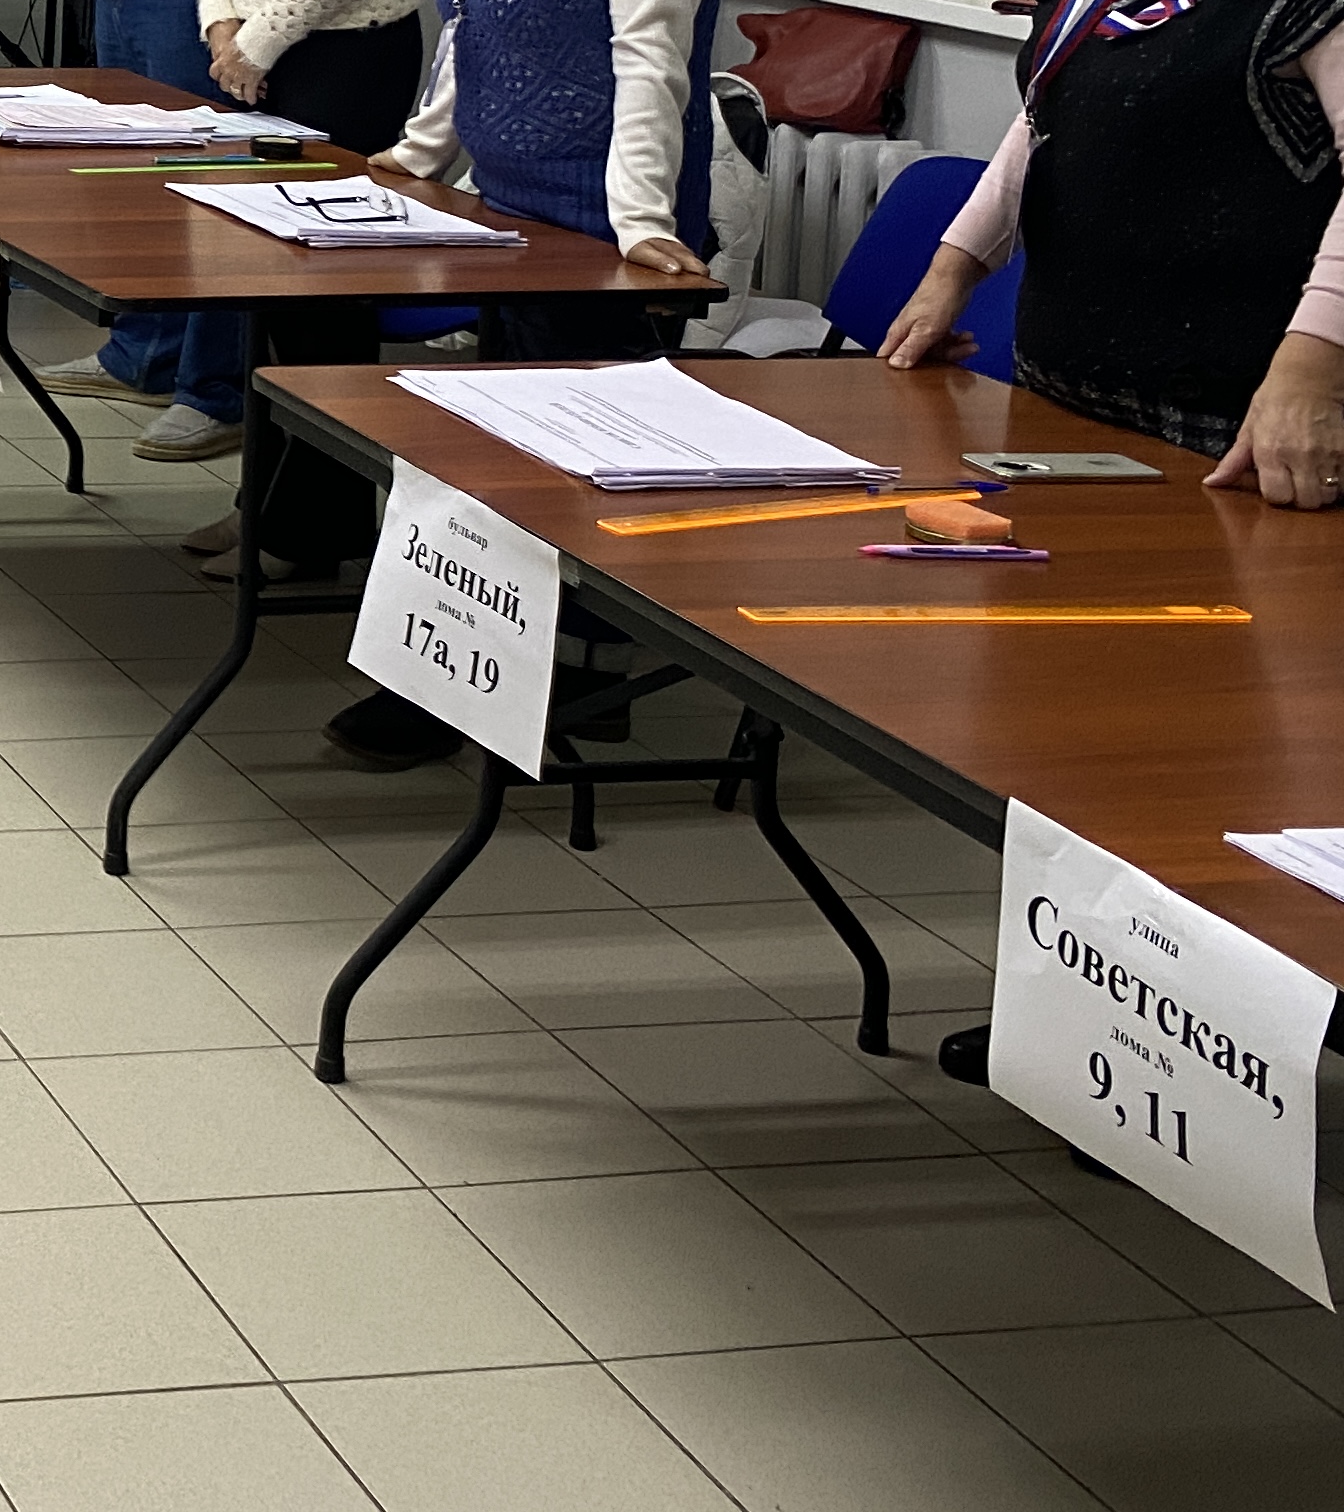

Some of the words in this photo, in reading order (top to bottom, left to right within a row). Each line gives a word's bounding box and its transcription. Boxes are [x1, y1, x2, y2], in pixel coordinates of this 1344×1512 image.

[447, 516, 489, 551] бульвар
[401, 523, 526, 636] Зеленый,
[434, 599, 462, 624] дома
[401, 612, 456, 681] 17а,
[467, 650, 500, 694] 19
[1127, 916, 1180, 959] улица
[1026, 895, 1285, 1120] Советская,
[1110, 1025, 1150, 1063] дома
[1154, 1051, 1175, 1078] №
[1088, 1050, 1127, 1128] 9,
[1143, 1090, 1195, 1167] 11
